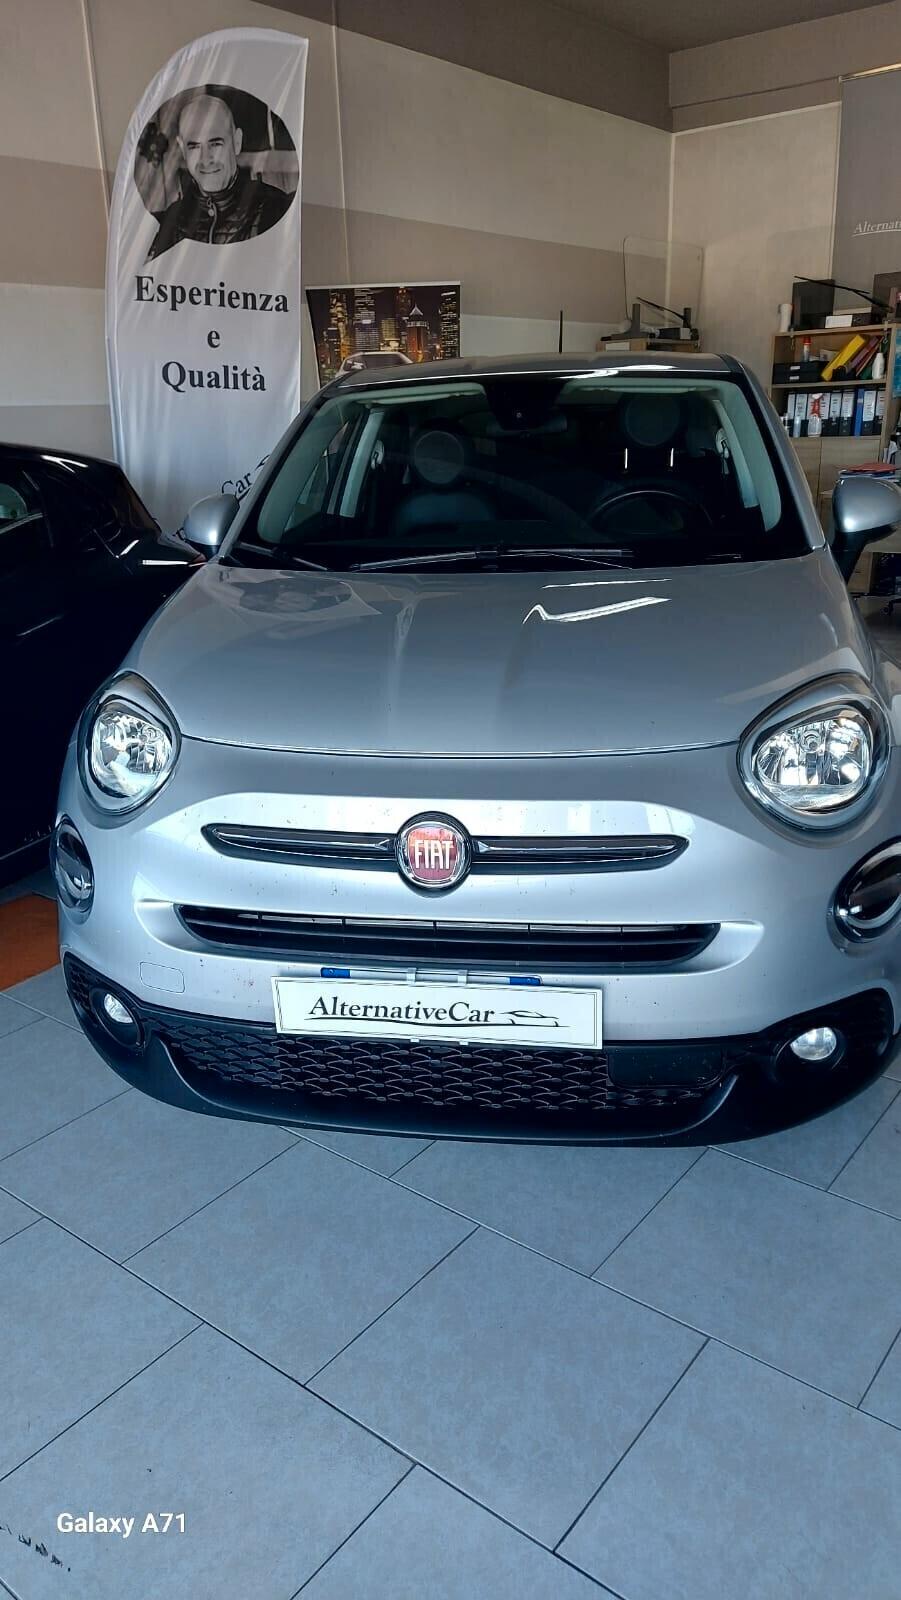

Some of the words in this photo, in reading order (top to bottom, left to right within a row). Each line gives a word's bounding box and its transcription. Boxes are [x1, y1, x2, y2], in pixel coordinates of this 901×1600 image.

[134, 275, 290, 313] Esperienza
[206, 330, 221, 349] e
[161, 361, 267, 393] Qualità
[414, 839, 454, 870] FIAT
[308, 995, 496, 1023] AlternativeCar
